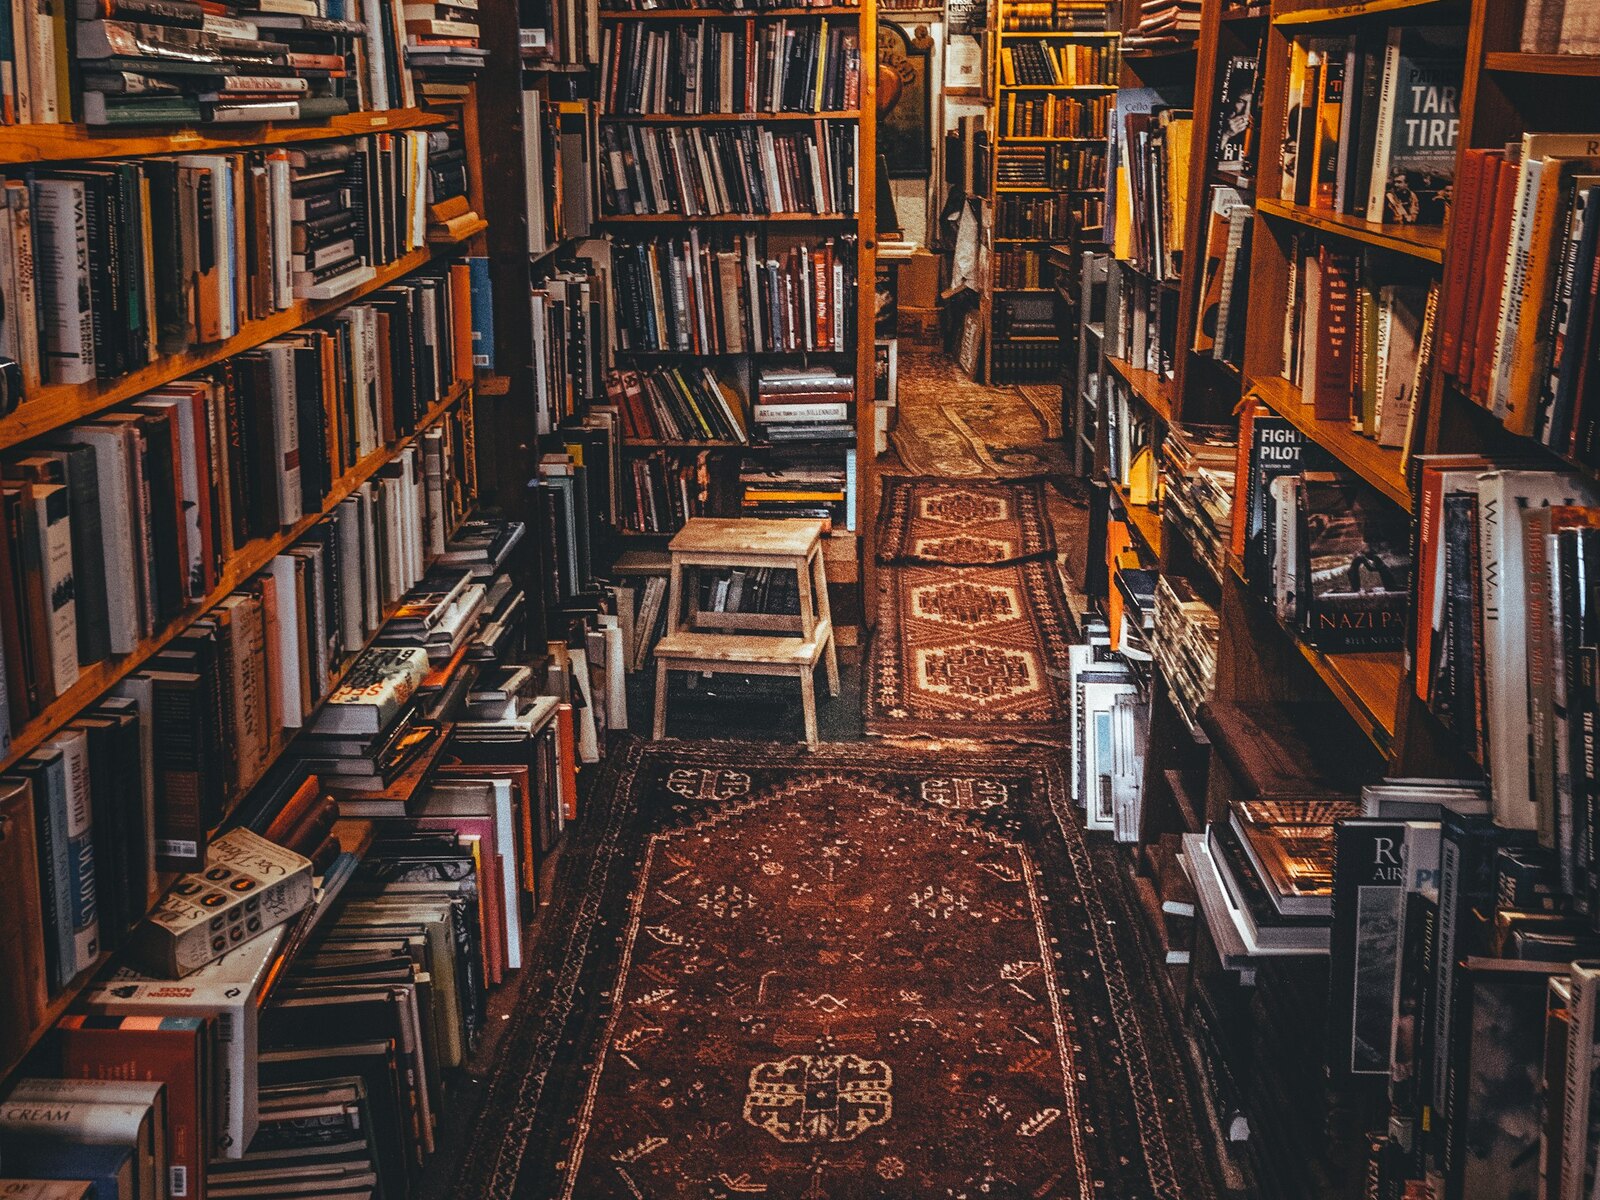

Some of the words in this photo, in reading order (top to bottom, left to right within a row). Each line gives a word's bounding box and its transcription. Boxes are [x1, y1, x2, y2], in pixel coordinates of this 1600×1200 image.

[1124, 102, 1149, 112] Cello
[1411, 86, 1456, 113] TAR
[74, 200, 87, 272] VALLEY
[1505, 246, 1523, 324] Psychologie
[1521, 171, 1535, 220] Einsatz
[1560, 236, 1569, 263] States
[1516, 249, 1529, 296] Notfall
[1552, 276, 1563, 301] World
[1513, 298, 1523, 325] und
[1548, 303, 1559, 337] Politics
[1260, 446, 1302, 460] PILOT
[1421, 506, 1431, 544] MEADOW
[1320, 611, 1373, 629] NAZI
[1487, 606, 1498, 621] II
[1583, 711, 1594, 733] THE
[1584, 734, 1595, 779] DELUGE
[1423, 909, 1434, 973] EVIDENCE
[1571, 983, 1582, 1008] The
[1566, 1014, 1580, 1084] Pictorial
[7, 1108, 71, 1122] CREAM
[1562, 1085, 1575, 1140] History
